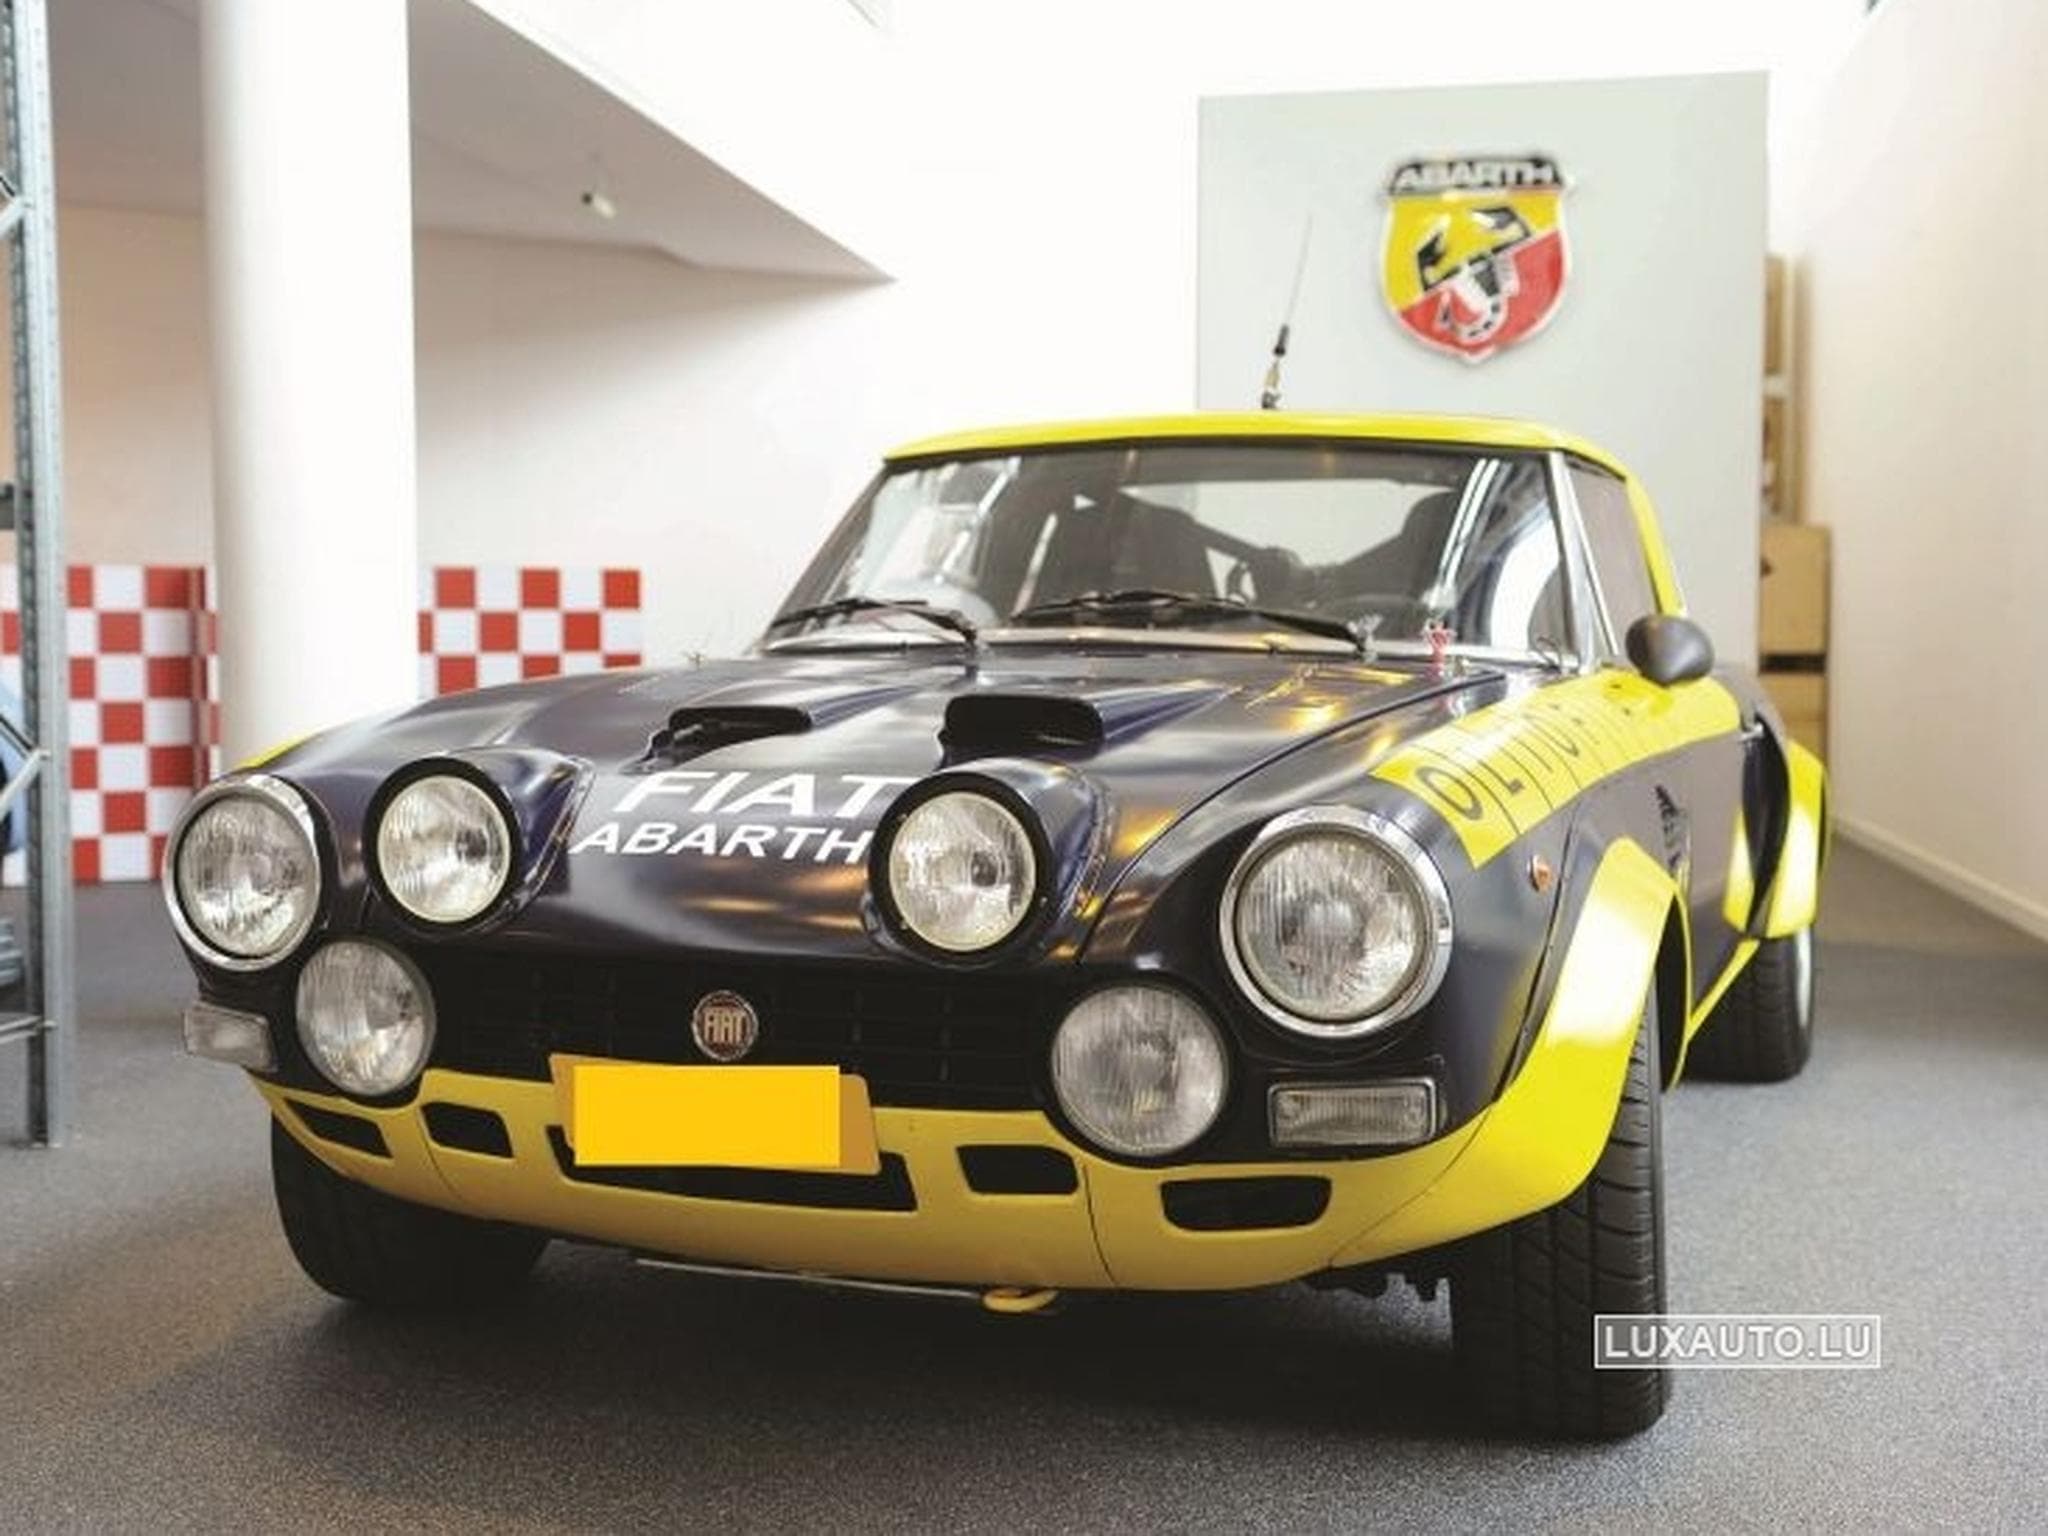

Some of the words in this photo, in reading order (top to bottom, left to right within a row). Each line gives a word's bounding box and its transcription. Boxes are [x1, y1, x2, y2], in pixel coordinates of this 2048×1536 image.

[612, 771, 923, 819] FIAT
[567, 822, 875, 864] ABARTH
[703, 1007, 750, 1043] FIAT
